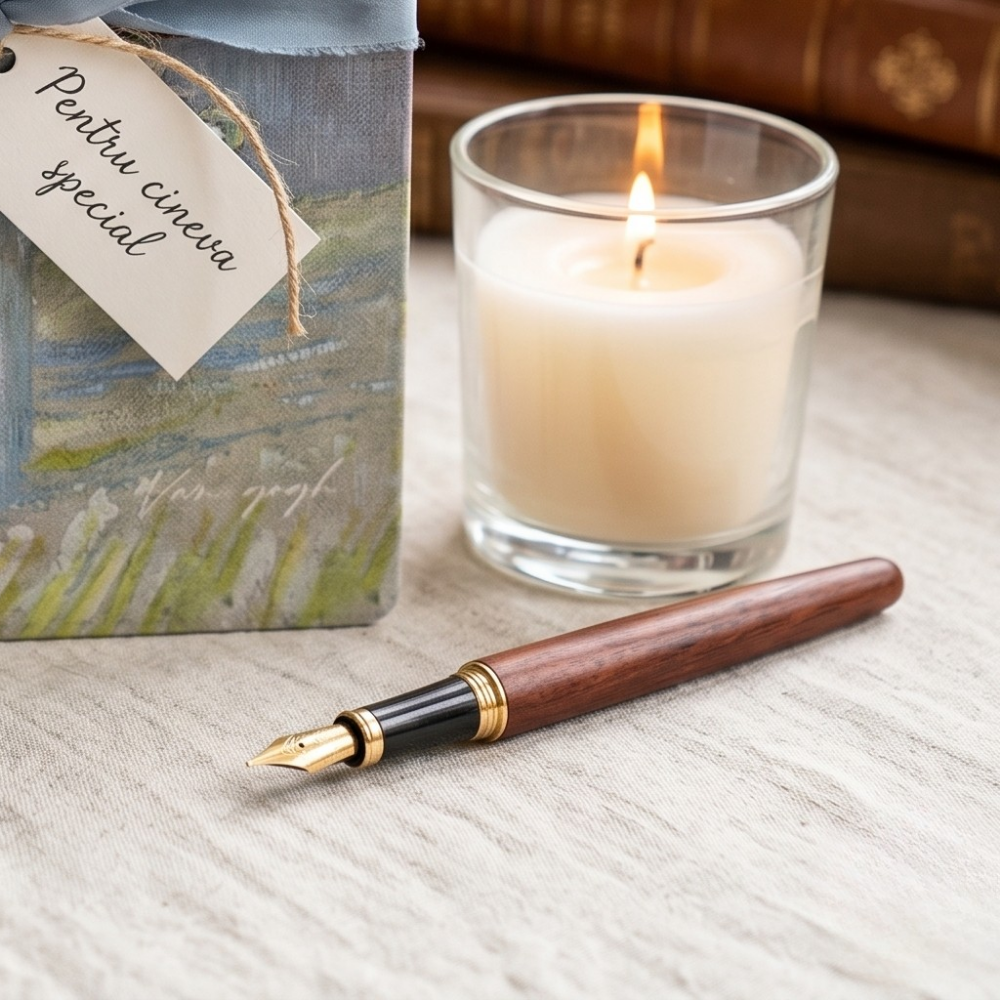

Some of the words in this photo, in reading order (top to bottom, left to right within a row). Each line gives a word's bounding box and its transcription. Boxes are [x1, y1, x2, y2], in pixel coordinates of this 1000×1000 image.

[34, 160, 167, 256] special
[35, 65, 140, 175] Pentru
[141, 181, 238, 272] cineva
